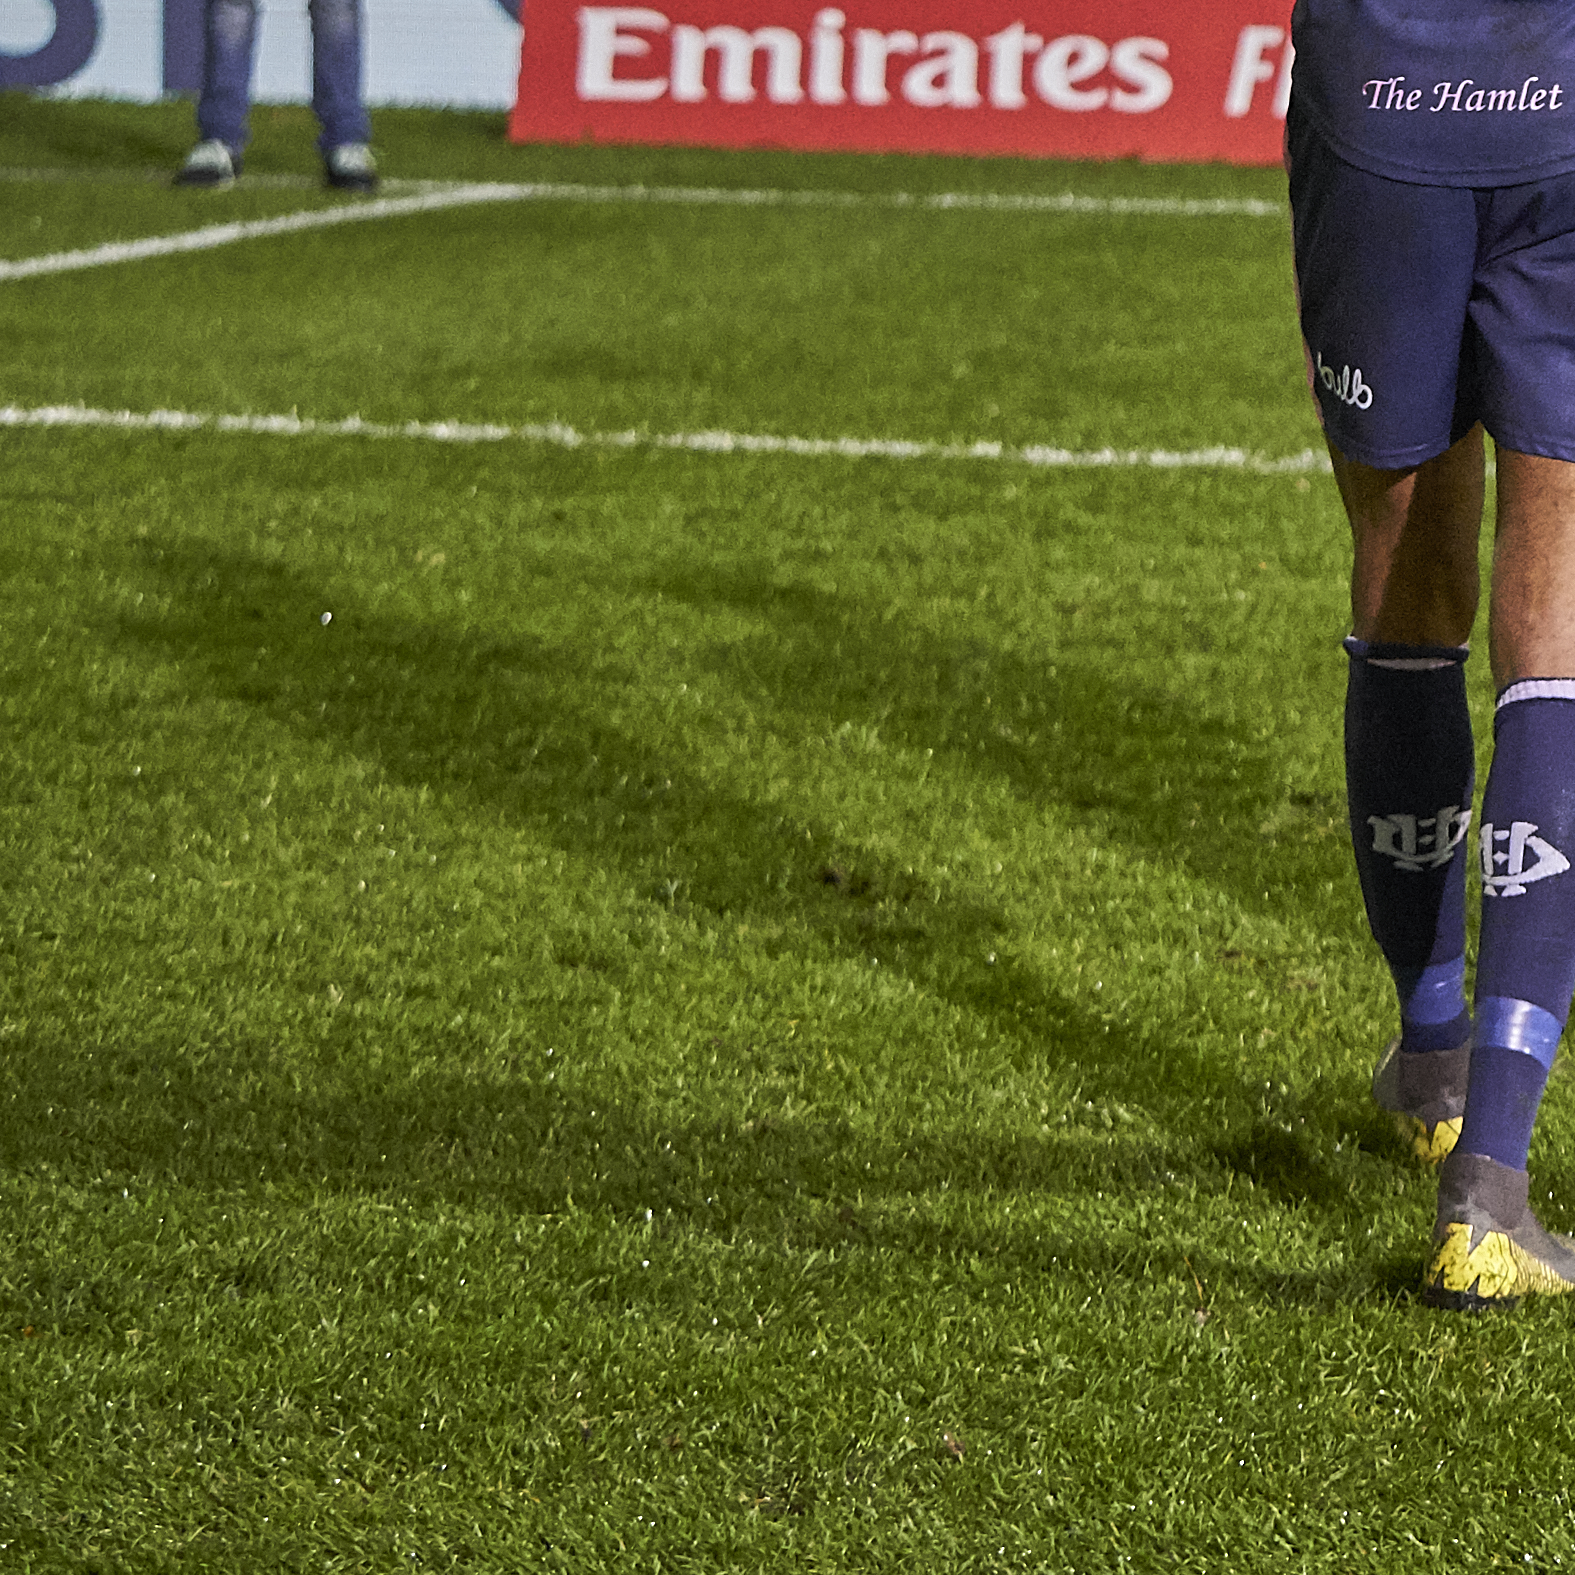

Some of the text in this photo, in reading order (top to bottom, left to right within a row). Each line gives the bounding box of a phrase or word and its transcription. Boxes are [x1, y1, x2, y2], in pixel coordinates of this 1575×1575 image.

[575, 6, 1175, 113] Emirates
[1362, 76, 1564, 113] The Hamlet
[1317, 350, 1374, 410] bulb
